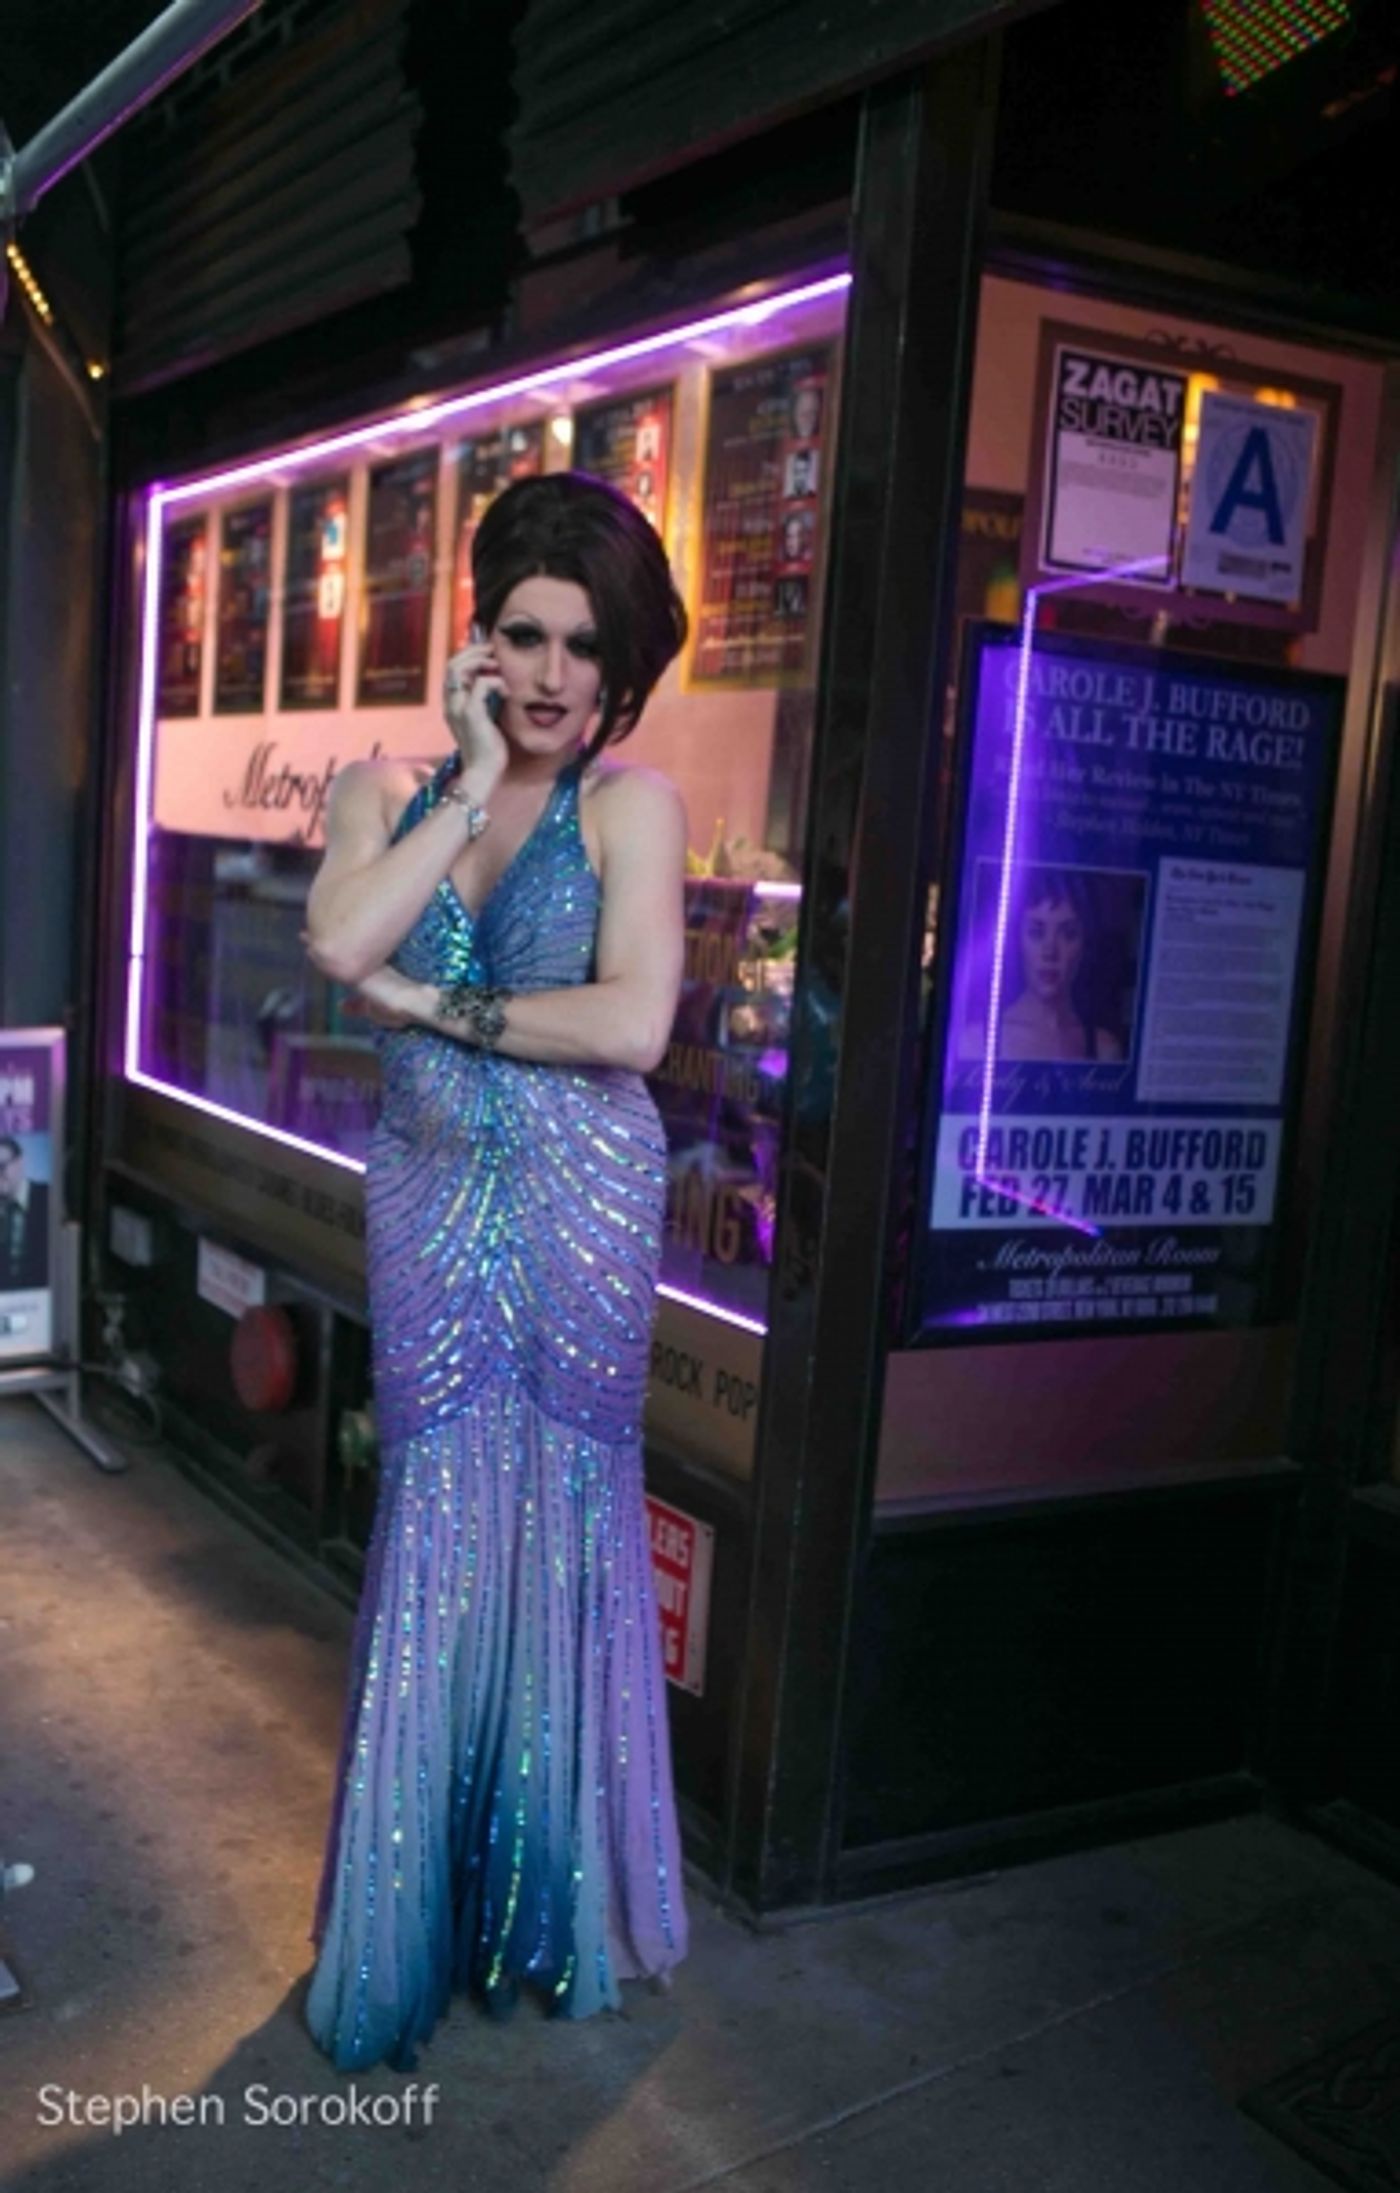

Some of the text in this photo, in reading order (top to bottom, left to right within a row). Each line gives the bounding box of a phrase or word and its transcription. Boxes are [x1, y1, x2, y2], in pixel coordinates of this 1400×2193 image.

[1063, 359, 1182, 416] ZAGAT
[1060, 398, 1178, 448] SURVEY
[1208, 424, 1287, 547] A
[1003, 661, 1311, 731] CAROLE J. BUFFORD
[1044, 705, 1115, 747] ALL
[1122, 713, 1198, 758] THE
[1205, 724, 1306, 770] RAGE!
[222, 738, 386, 842] Metrop
[958, 1127, 1268, 1172] CAROLE J. BUFFORD
[959, 1173, 1020, 1218] FEB
[1082, 1174, 1155, 1216] MAR
[1162, 1174, 1183, 1214] 4
[1189, 1180, 1211, 1215] &
[1221, 1173, 1256, 1214] 15
[976, 1236, 1223, 1279] Metropolitan Room
[651, 1340, 755, 1424] ROCK POP
